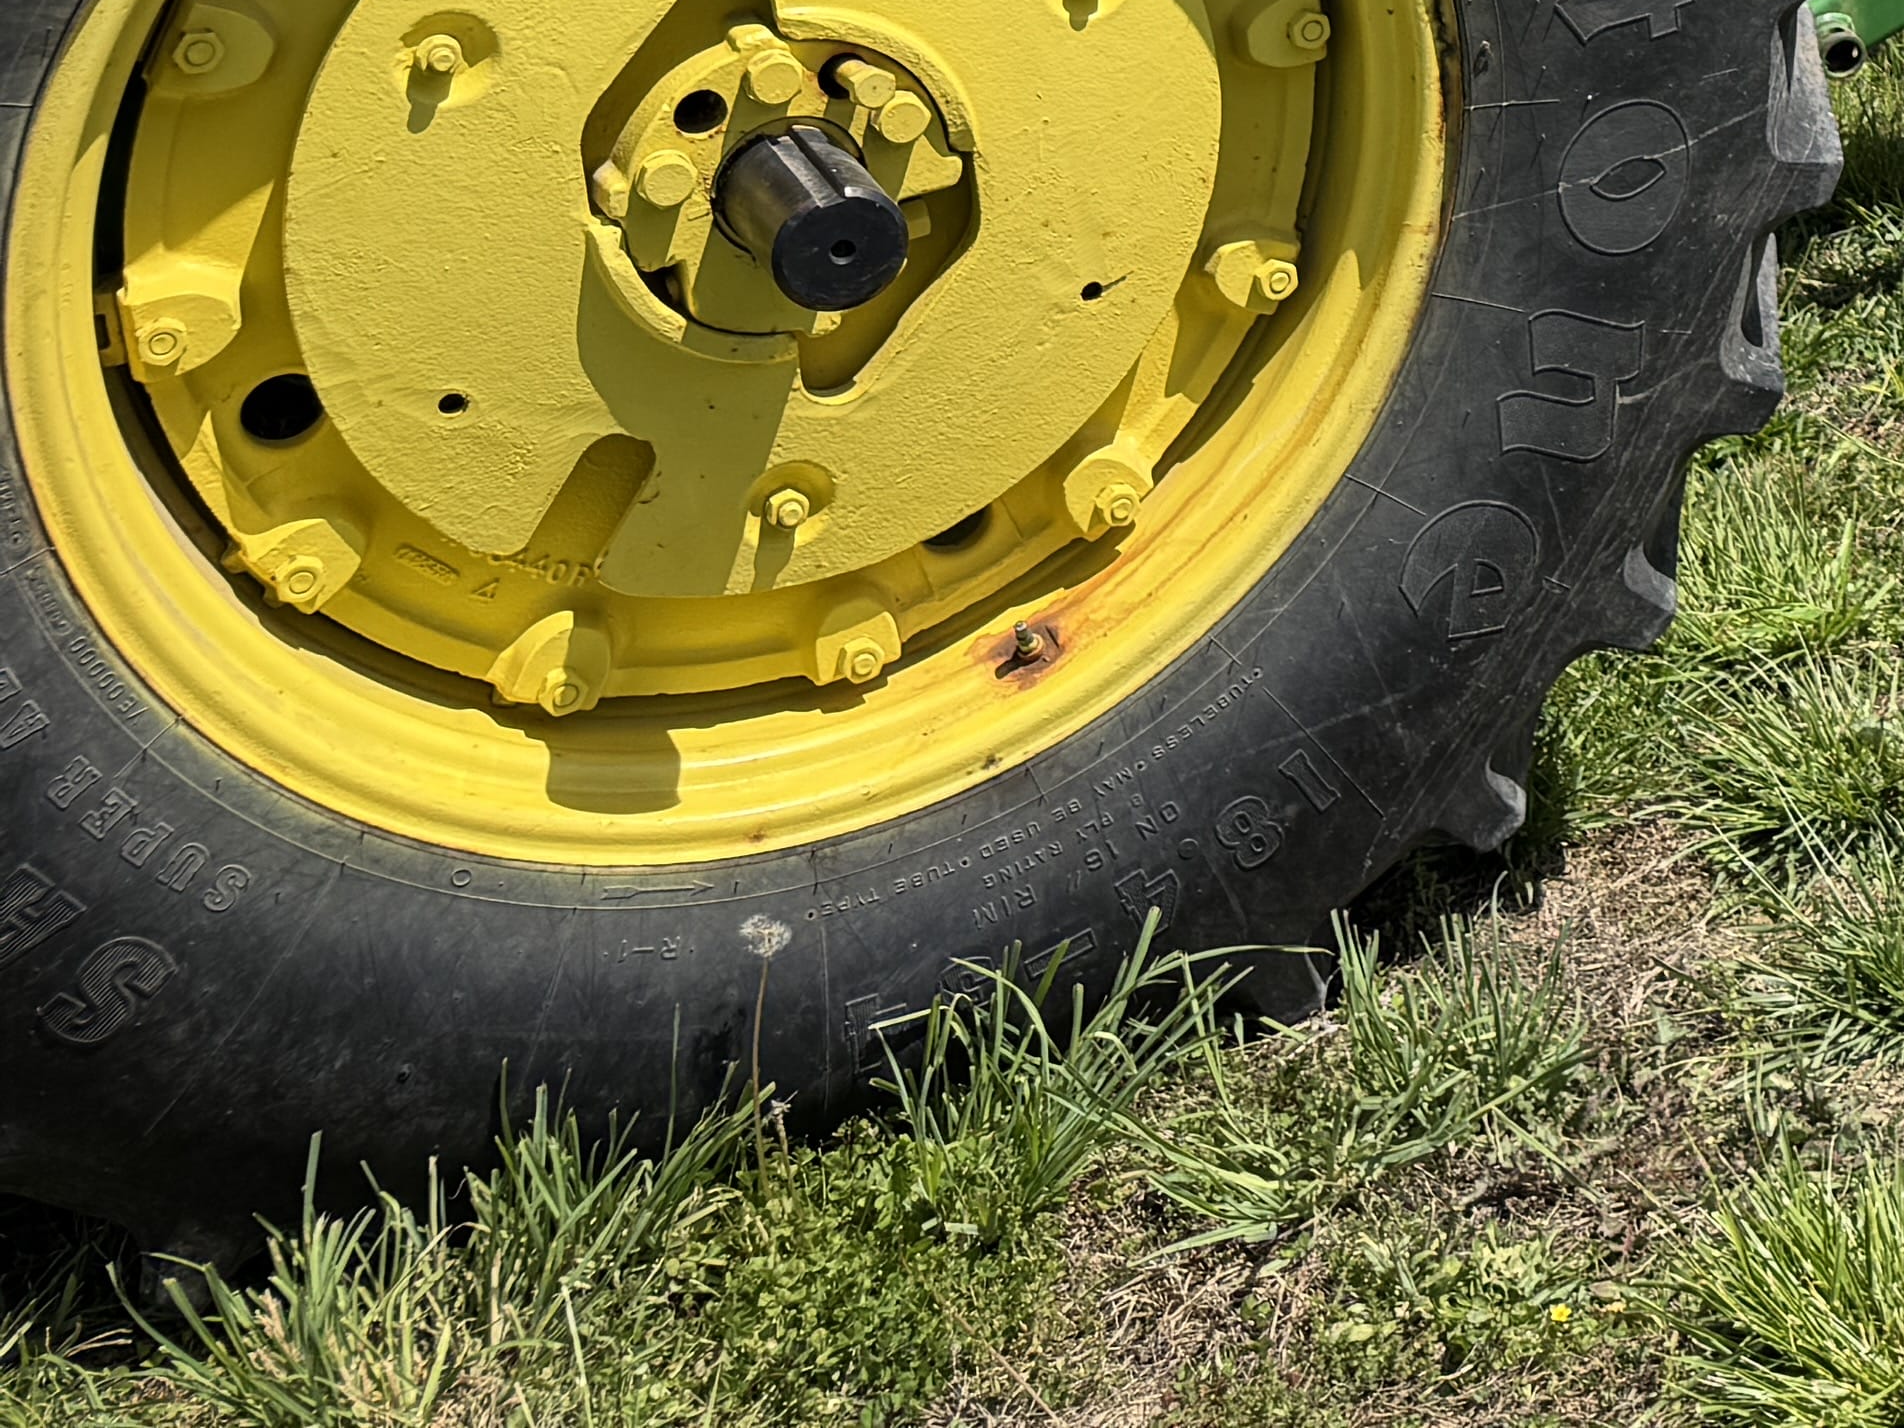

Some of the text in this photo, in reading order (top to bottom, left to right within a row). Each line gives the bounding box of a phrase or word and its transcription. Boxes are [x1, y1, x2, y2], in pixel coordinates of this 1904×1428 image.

[820, 674, 1255, 917] TUBELESS MAY BE USED TUBE TYPE
[47, 754, 251, 912] SUPER
[1135, 800, 1182, 841] ON
[981, 840, 1064, 889] RATING
[971, 883, 1038, 929] RIM
